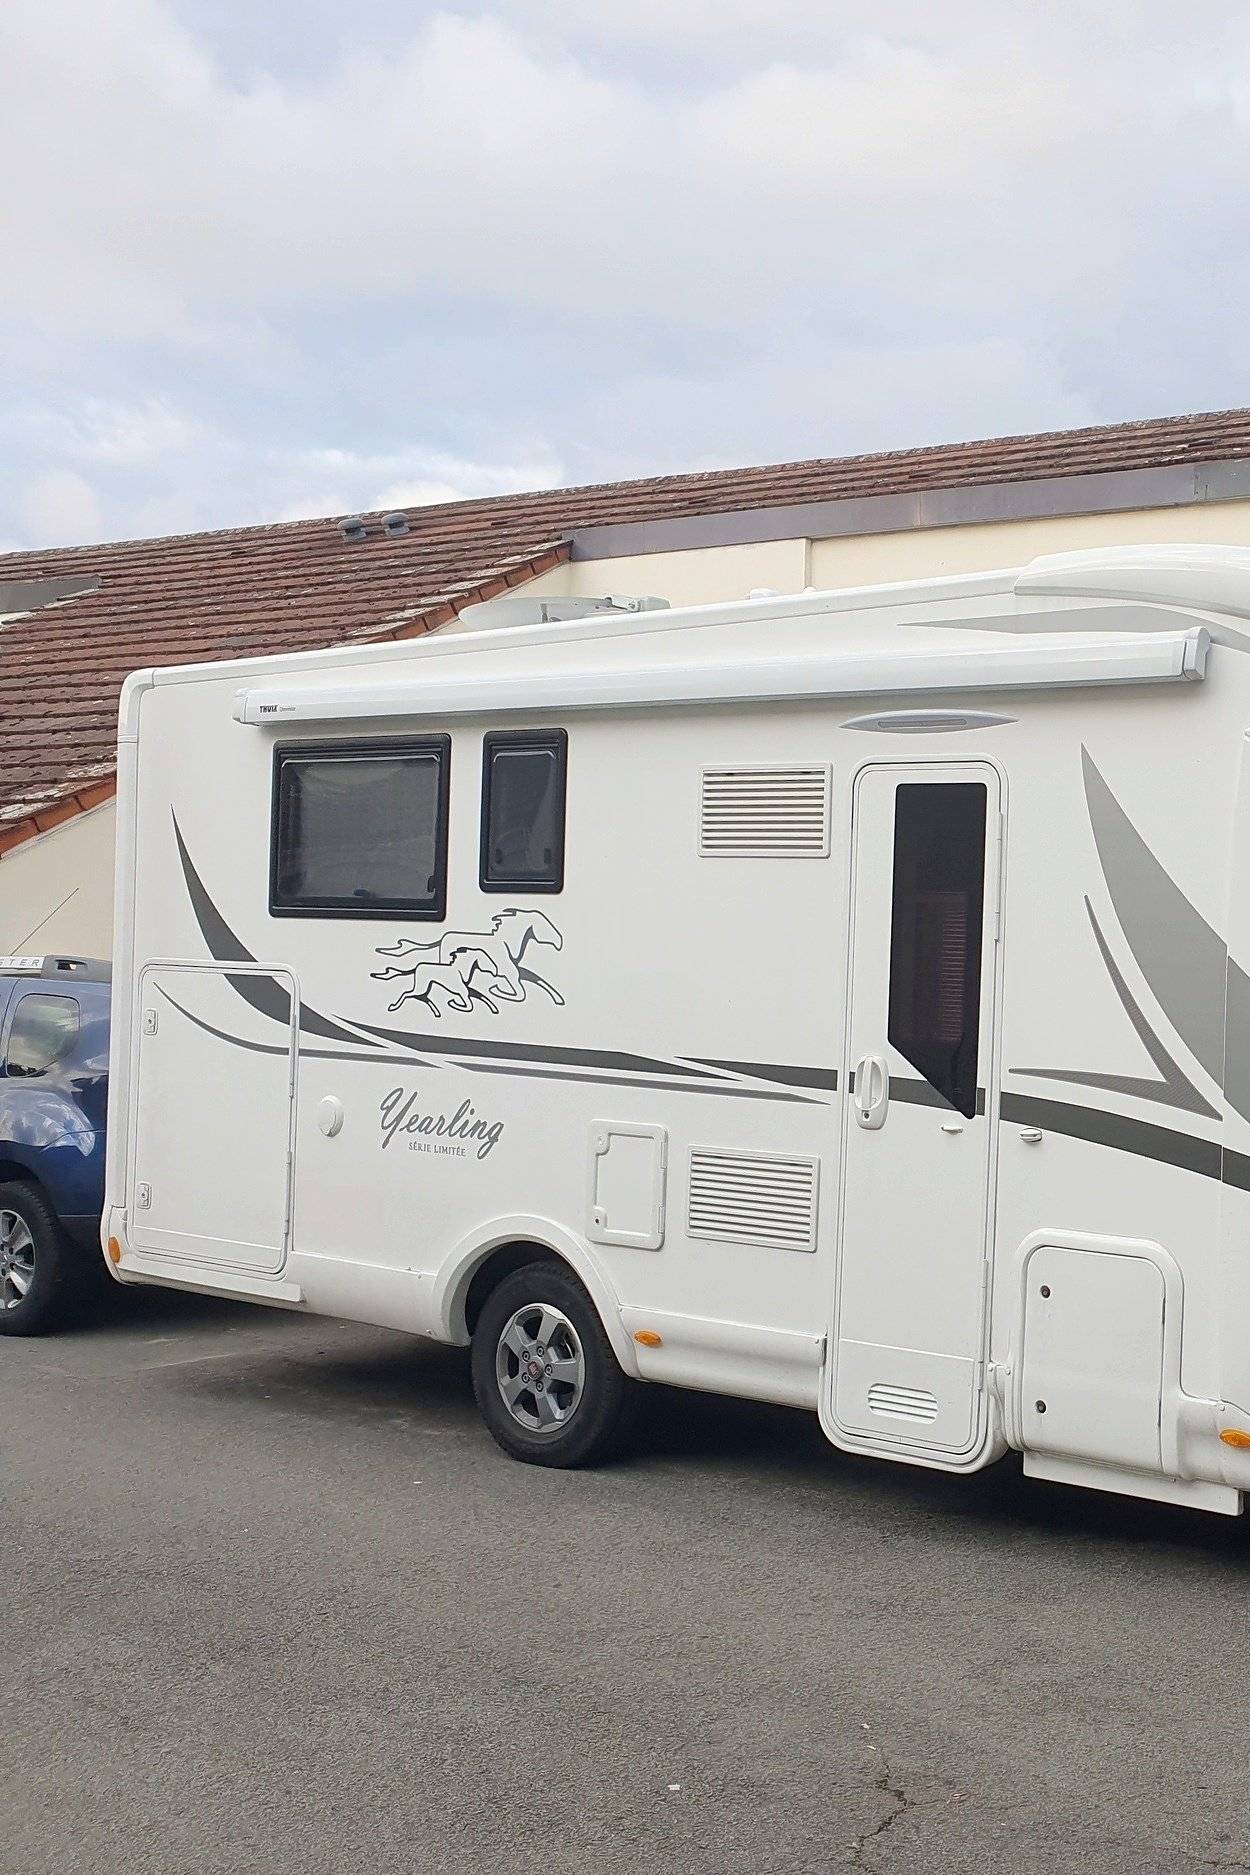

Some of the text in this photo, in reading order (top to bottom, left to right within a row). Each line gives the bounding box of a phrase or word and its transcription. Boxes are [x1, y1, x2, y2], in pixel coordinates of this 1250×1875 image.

[380, 1087, 505, 1160] Yearling
[408, 1141, 467, 1157] SÉRIE LIMITÉE
